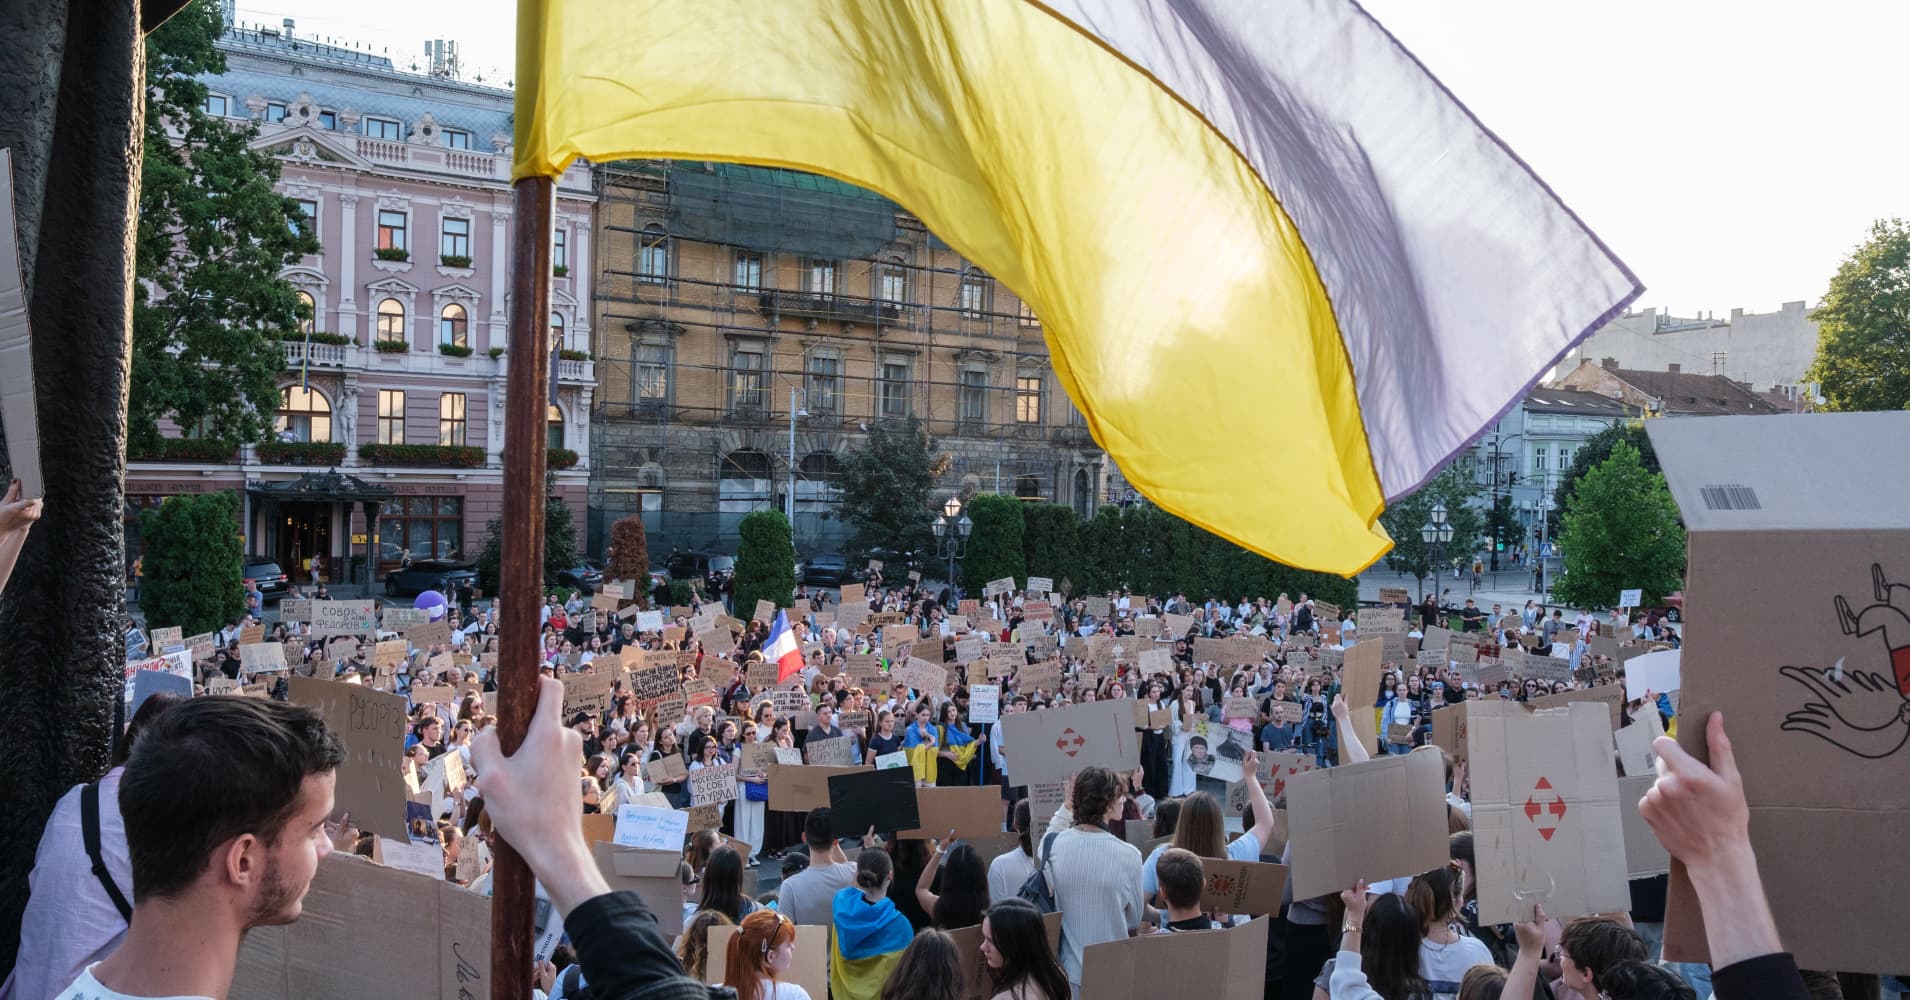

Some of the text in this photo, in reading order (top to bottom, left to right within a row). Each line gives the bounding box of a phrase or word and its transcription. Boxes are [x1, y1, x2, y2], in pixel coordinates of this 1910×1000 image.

[322, 606, 357, 617] СОВОК
[315, 620, 359, 630] ФЕДОРОВ
[657, 663, 677, 673] ВІЙНА
[631, 679, 640, 689] НЕ
[691, 769, 735, 785] МОСКОВСЬКЕ
[706, 779, 727, 791] СОБІ
[695, 793, 706, 805] ТА
